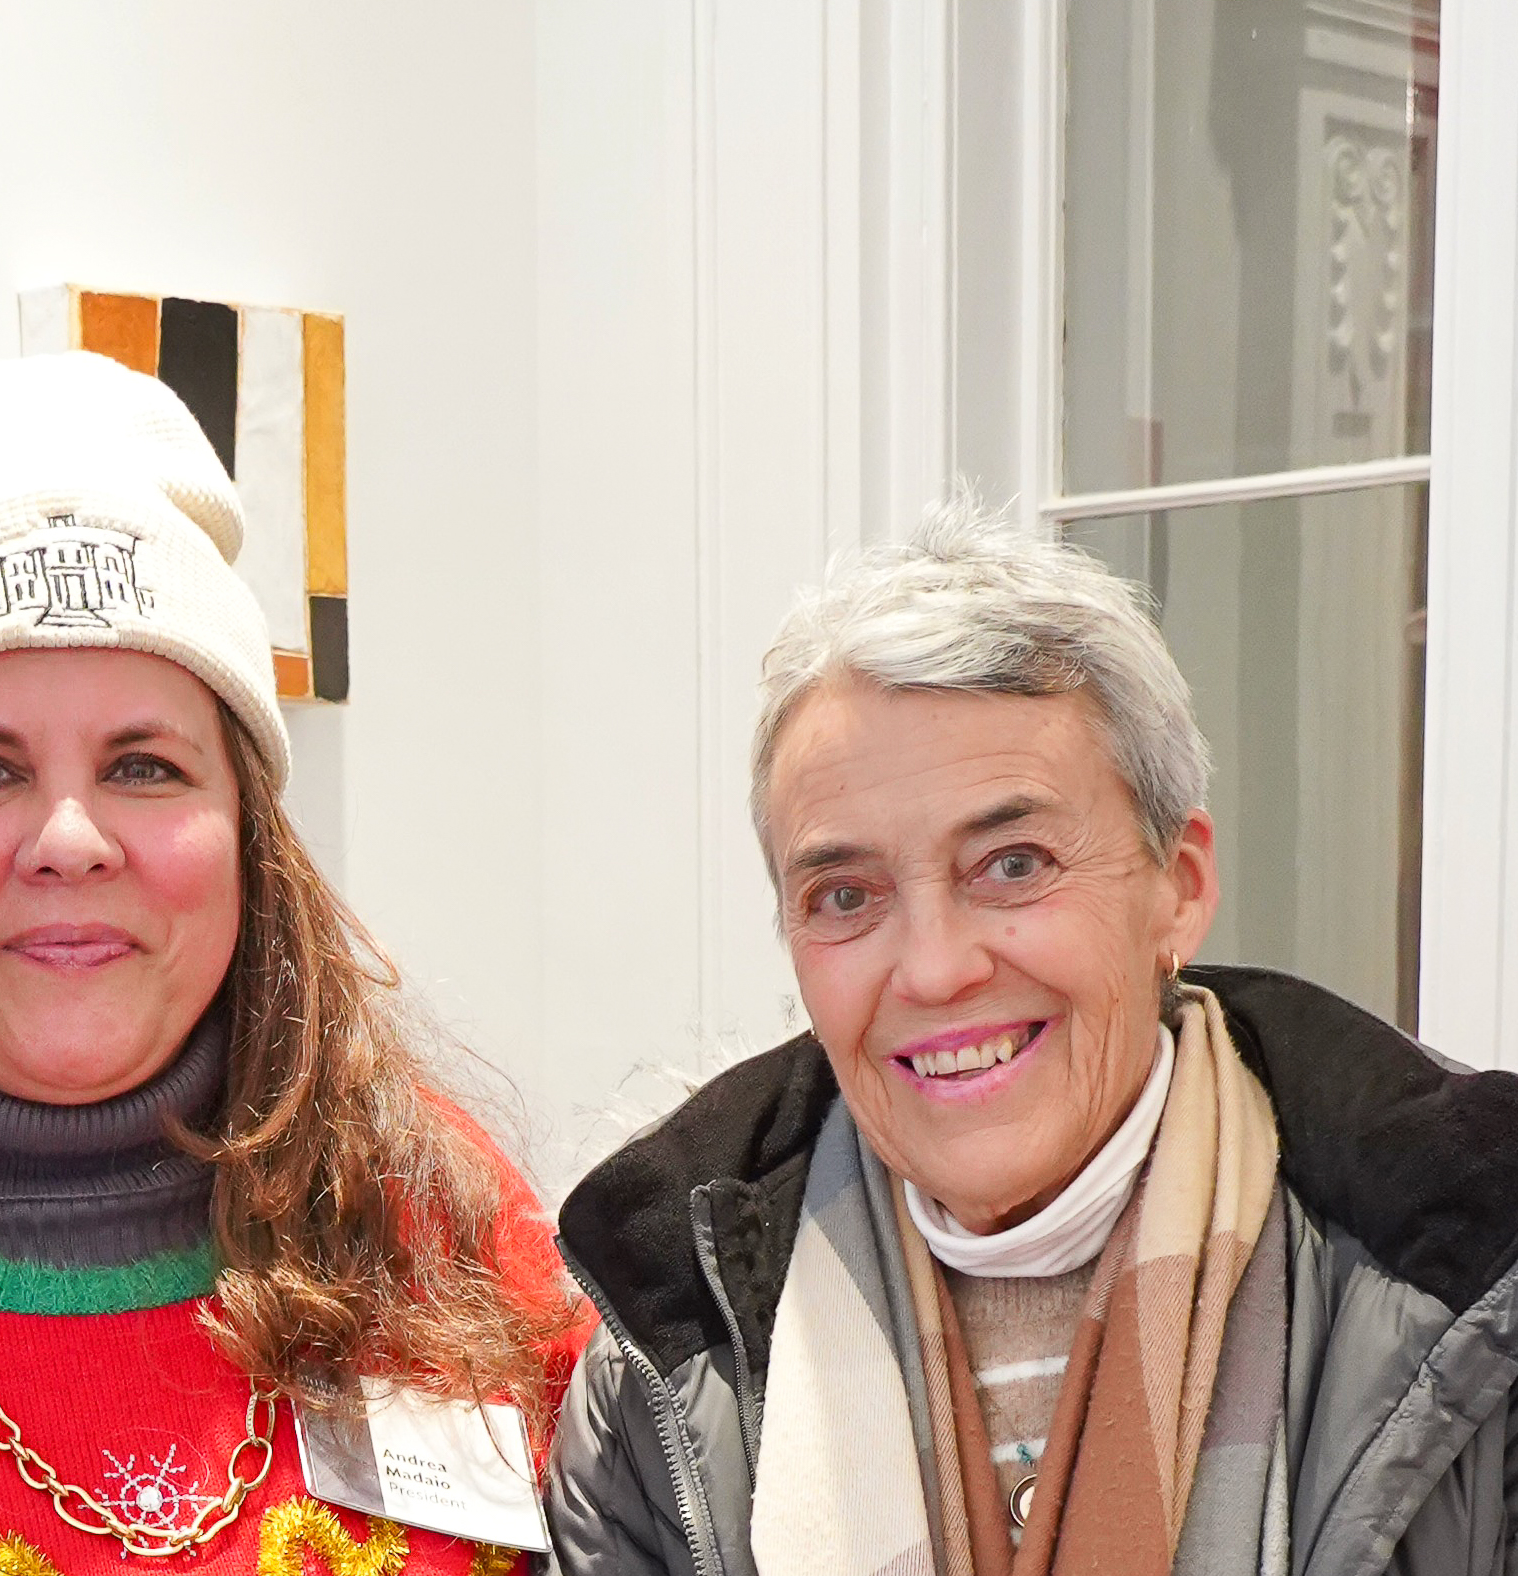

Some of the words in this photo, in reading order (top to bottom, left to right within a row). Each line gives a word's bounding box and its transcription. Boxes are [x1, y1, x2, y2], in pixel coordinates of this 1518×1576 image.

[383, 1448, 447, 1473] Andrea
[386, 1465, 451, 1490] Madaio
[389, 1481, 467, 1511] President
